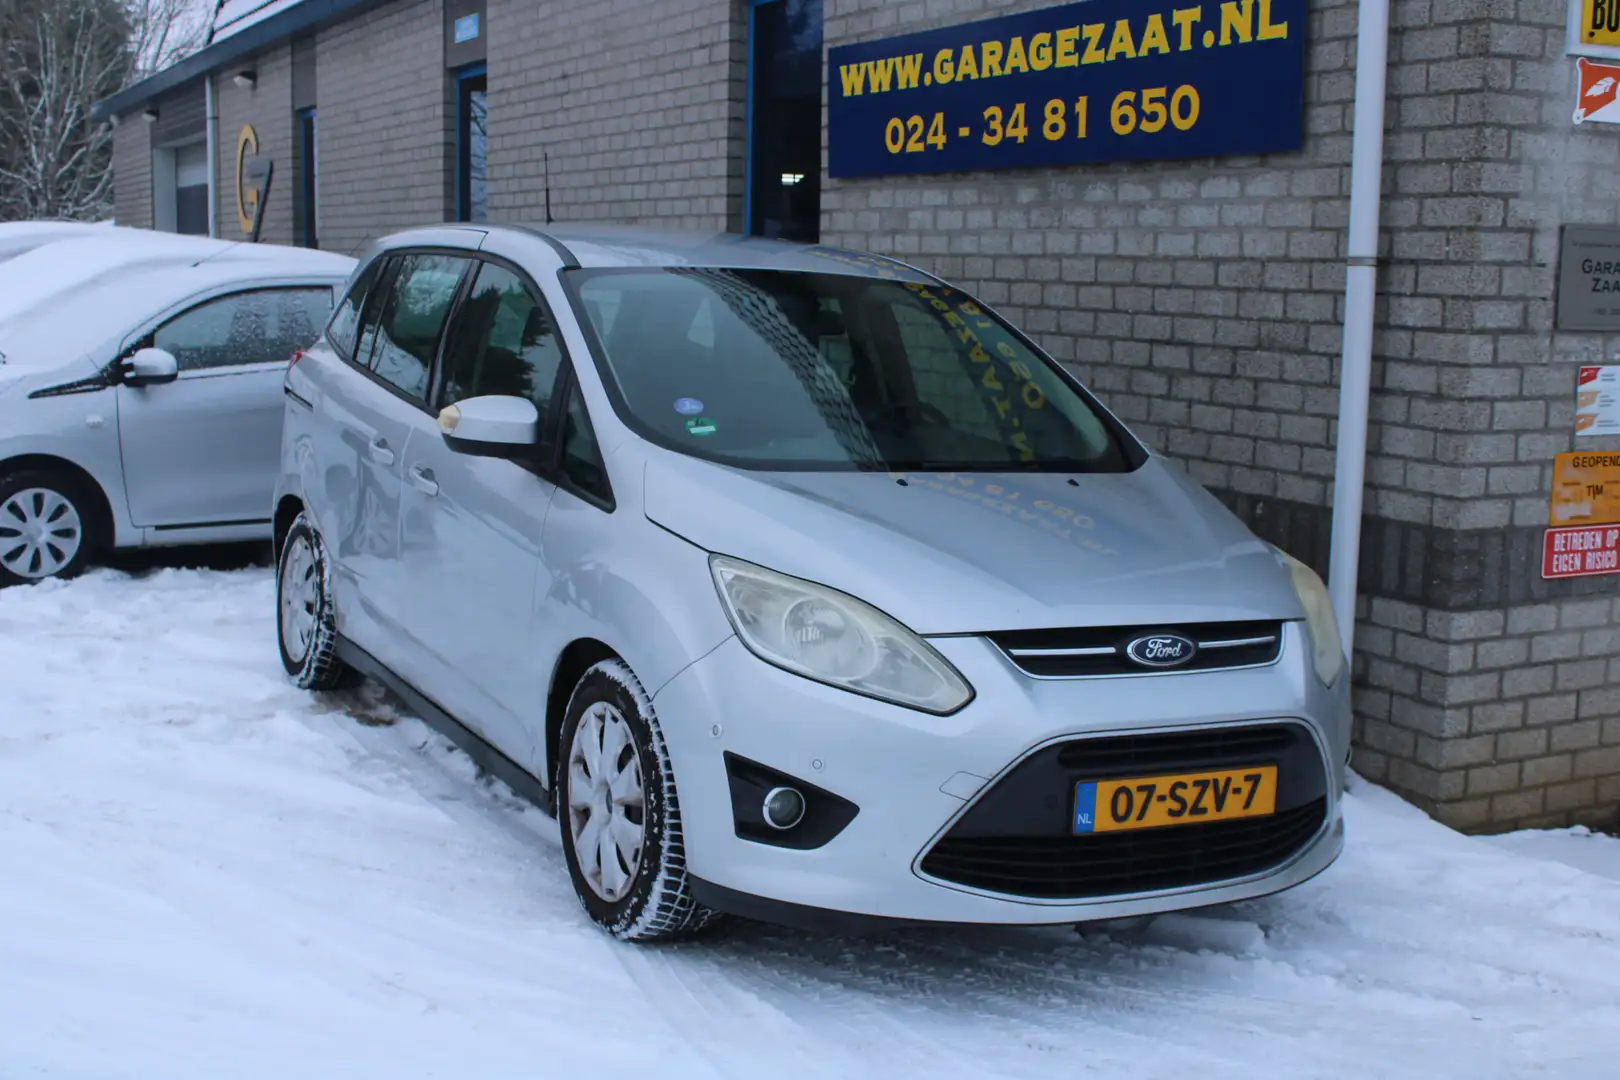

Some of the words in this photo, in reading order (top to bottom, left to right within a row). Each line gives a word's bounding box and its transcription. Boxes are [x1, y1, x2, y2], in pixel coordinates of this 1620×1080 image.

[839, 0, 1288, 96] WWW.GARAGEZAAT.NL
[885, 111, 946, 153] 024
[982, 103, 1028, 145] 34
[1043, 95, 1088, 140] 81
[1110, 84, 1200, 135] 650
[1554, 531, 1602, 551] BETREDEN
[1606, 529, 1619, 547] OP
[1552, 553, 1581, 573] EIGEN
[1586, 550, 1617, 569] RISICO
[1145, 638, 1183, 658] Ford
[1110, 773, 1262, 823] 07-SZV-7
[1077, 813, 1092, 825] NL
